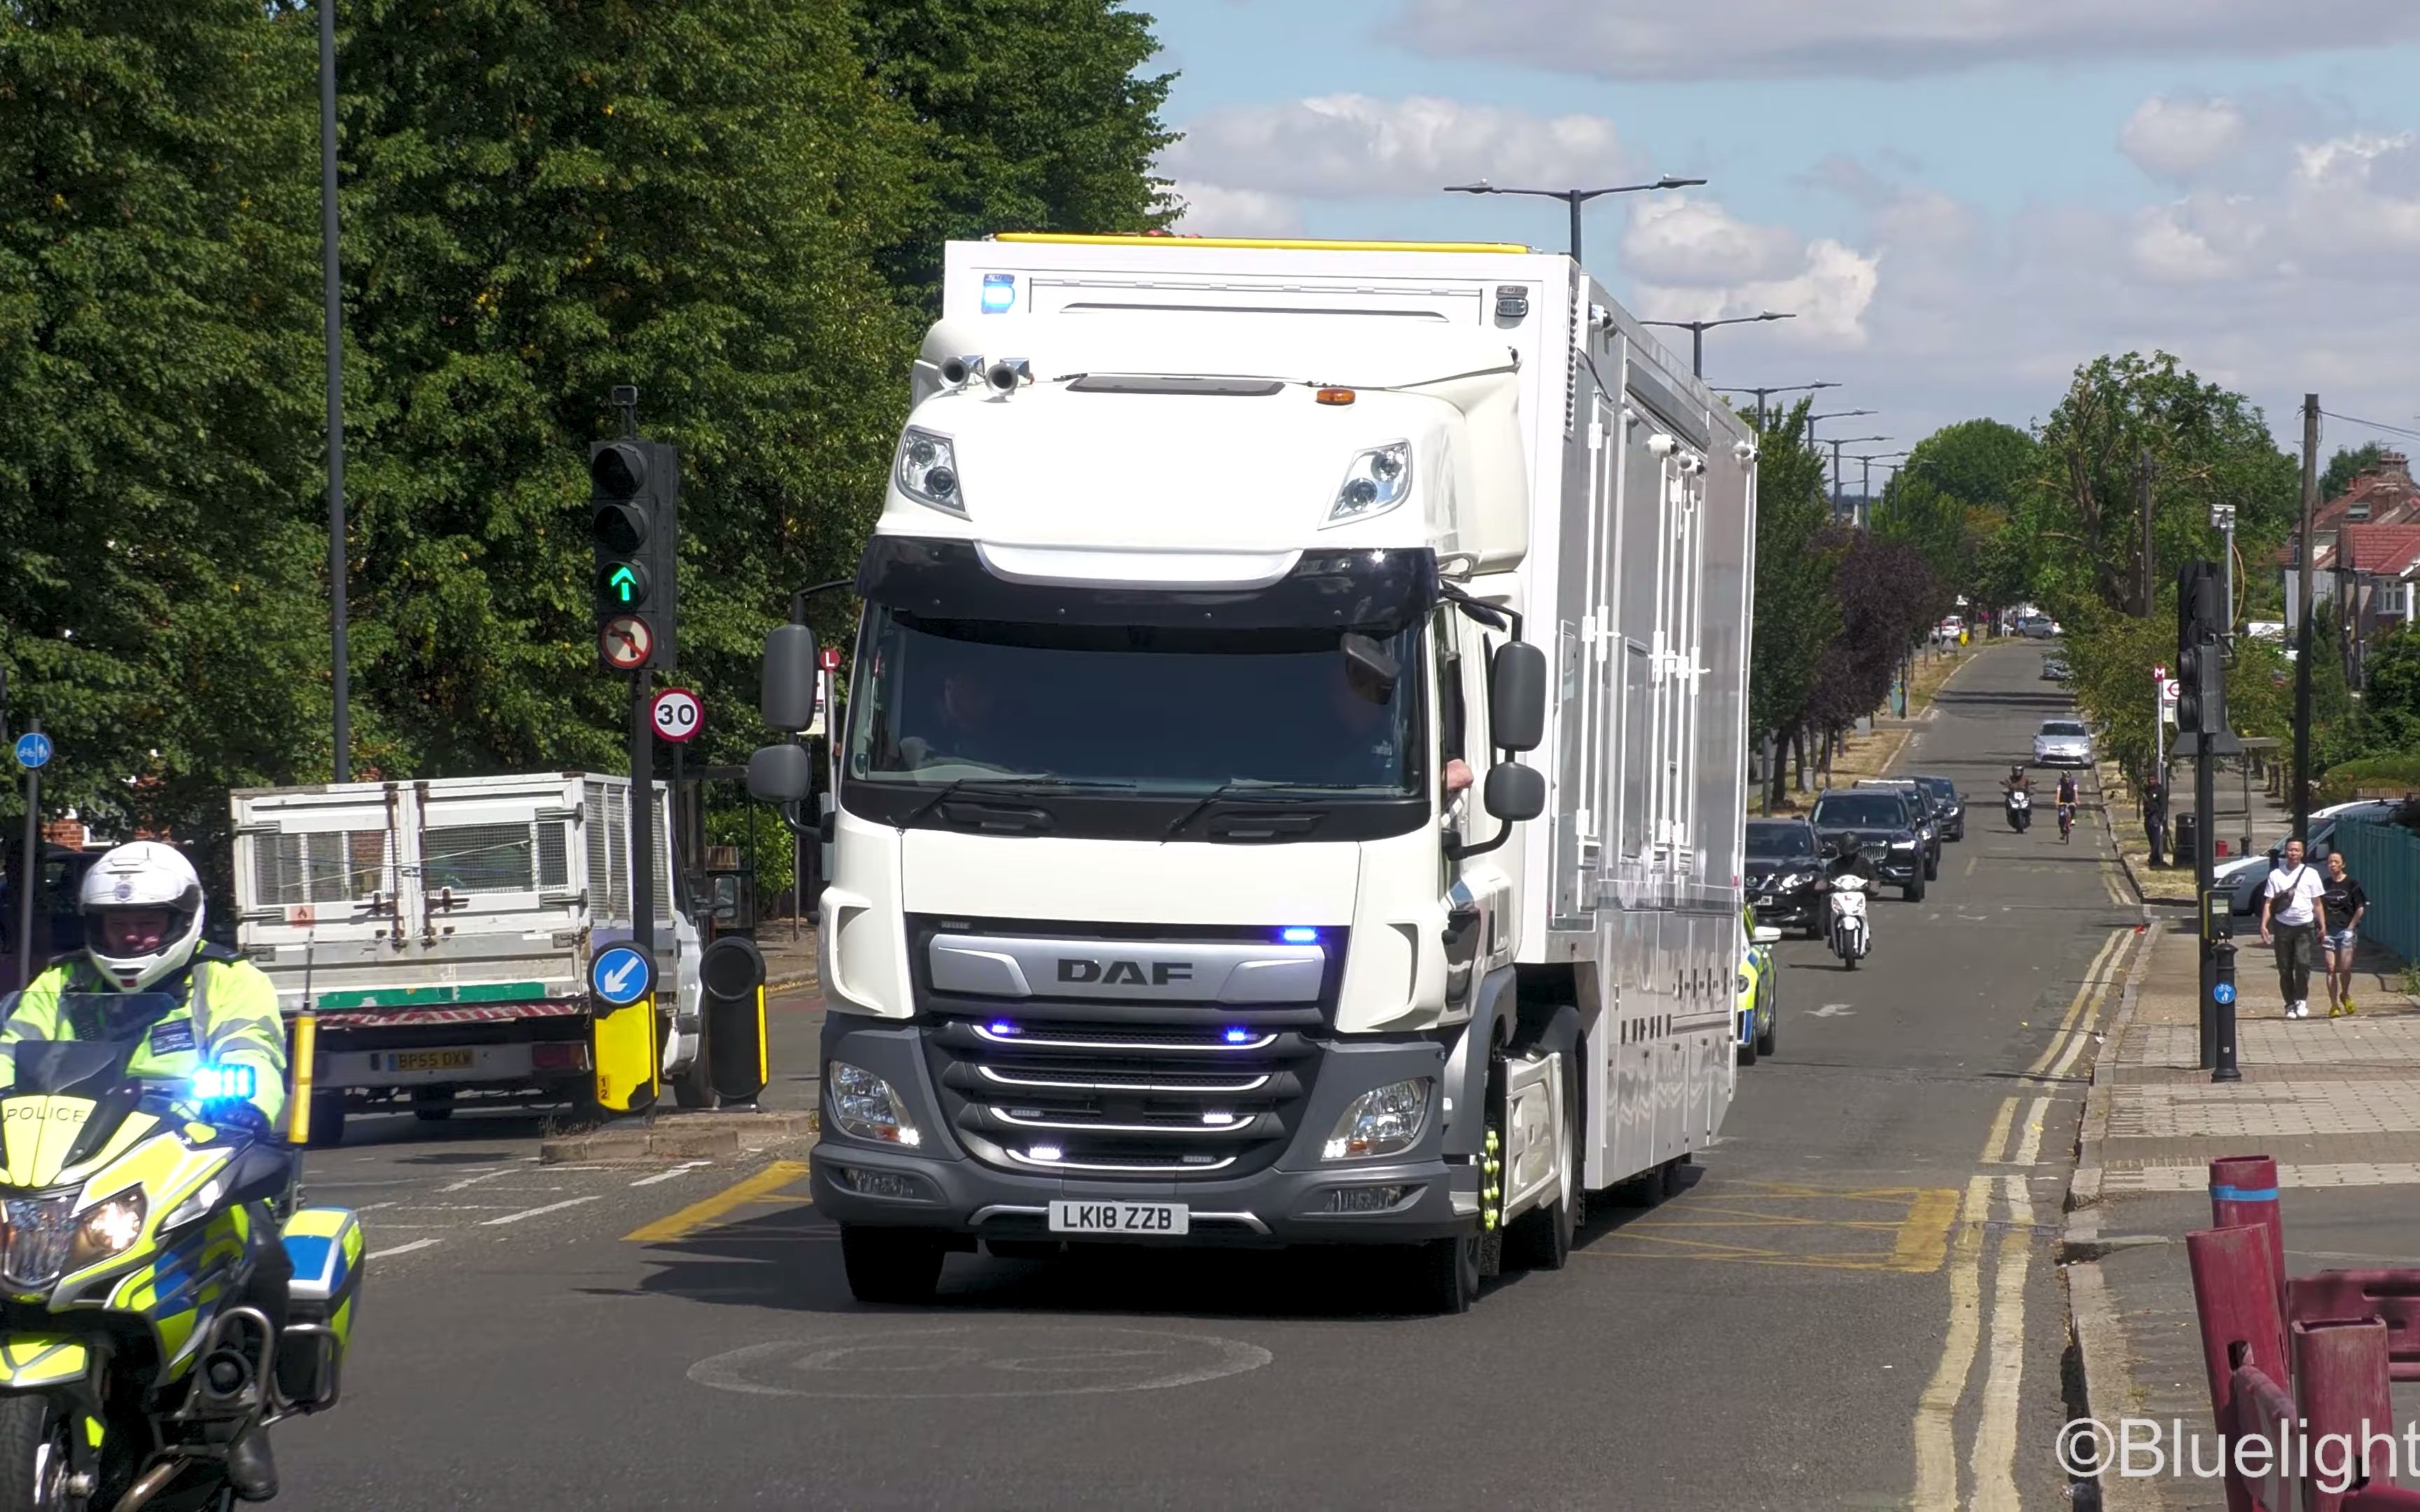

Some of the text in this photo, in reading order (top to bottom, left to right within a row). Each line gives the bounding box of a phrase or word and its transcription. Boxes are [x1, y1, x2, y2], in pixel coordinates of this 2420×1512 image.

[825, 651, 835, 667] L
[2155, 668, 2165, 678] M
[658, 704, 695, 726] 30
[1057, 958, 1193, 986] DAF
[599, 1078, 606, 1087] 1
[600, 1089, 609, 1100] 2
[4, 1107, 86, 1124] POLICE
[1063, 1205, 1171, 1230] LK18 ZZB
